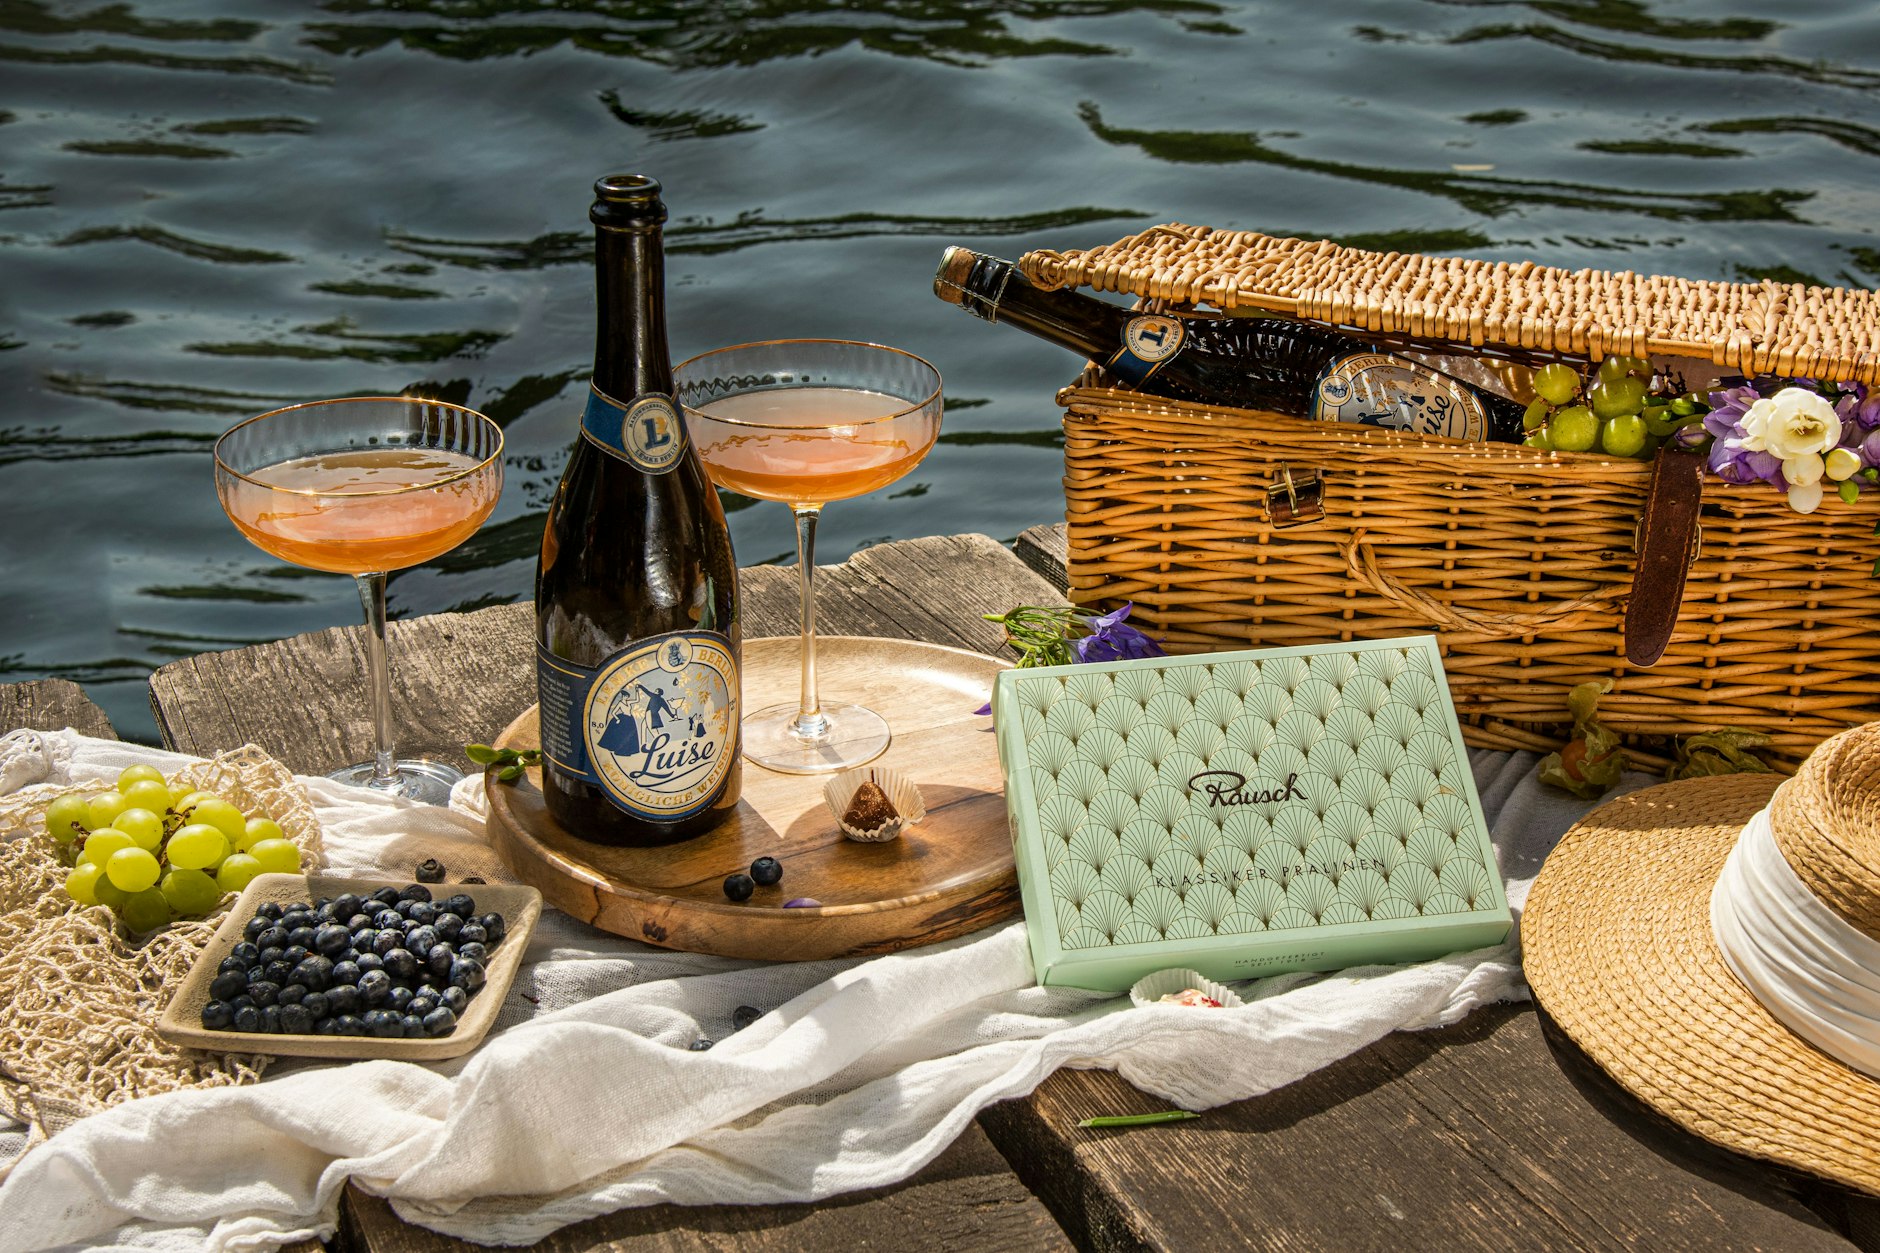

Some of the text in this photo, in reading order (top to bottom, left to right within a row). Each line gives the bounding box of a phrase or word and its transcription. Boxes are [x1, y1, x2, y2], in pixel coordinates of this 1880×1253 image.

[1346, 357, 1400, 375] BERLIN
[1453, 385, 1479, 424] WEISS
[635, 441, 679, 463] LEMKE BERLIN
[596, 649, 735, 705] LEMKE BERLIN
[602, 741, 731, 806] KÖNIGLICHE WEISSE
[630, 732, 717, 780] Luise
[1188, 770, 1308, 808] Rausch
[1156, 858, 1386, 888] KLASSIKER PRALINEN
[1234, 951, 1326, 964] HANDGEFERTIGT
